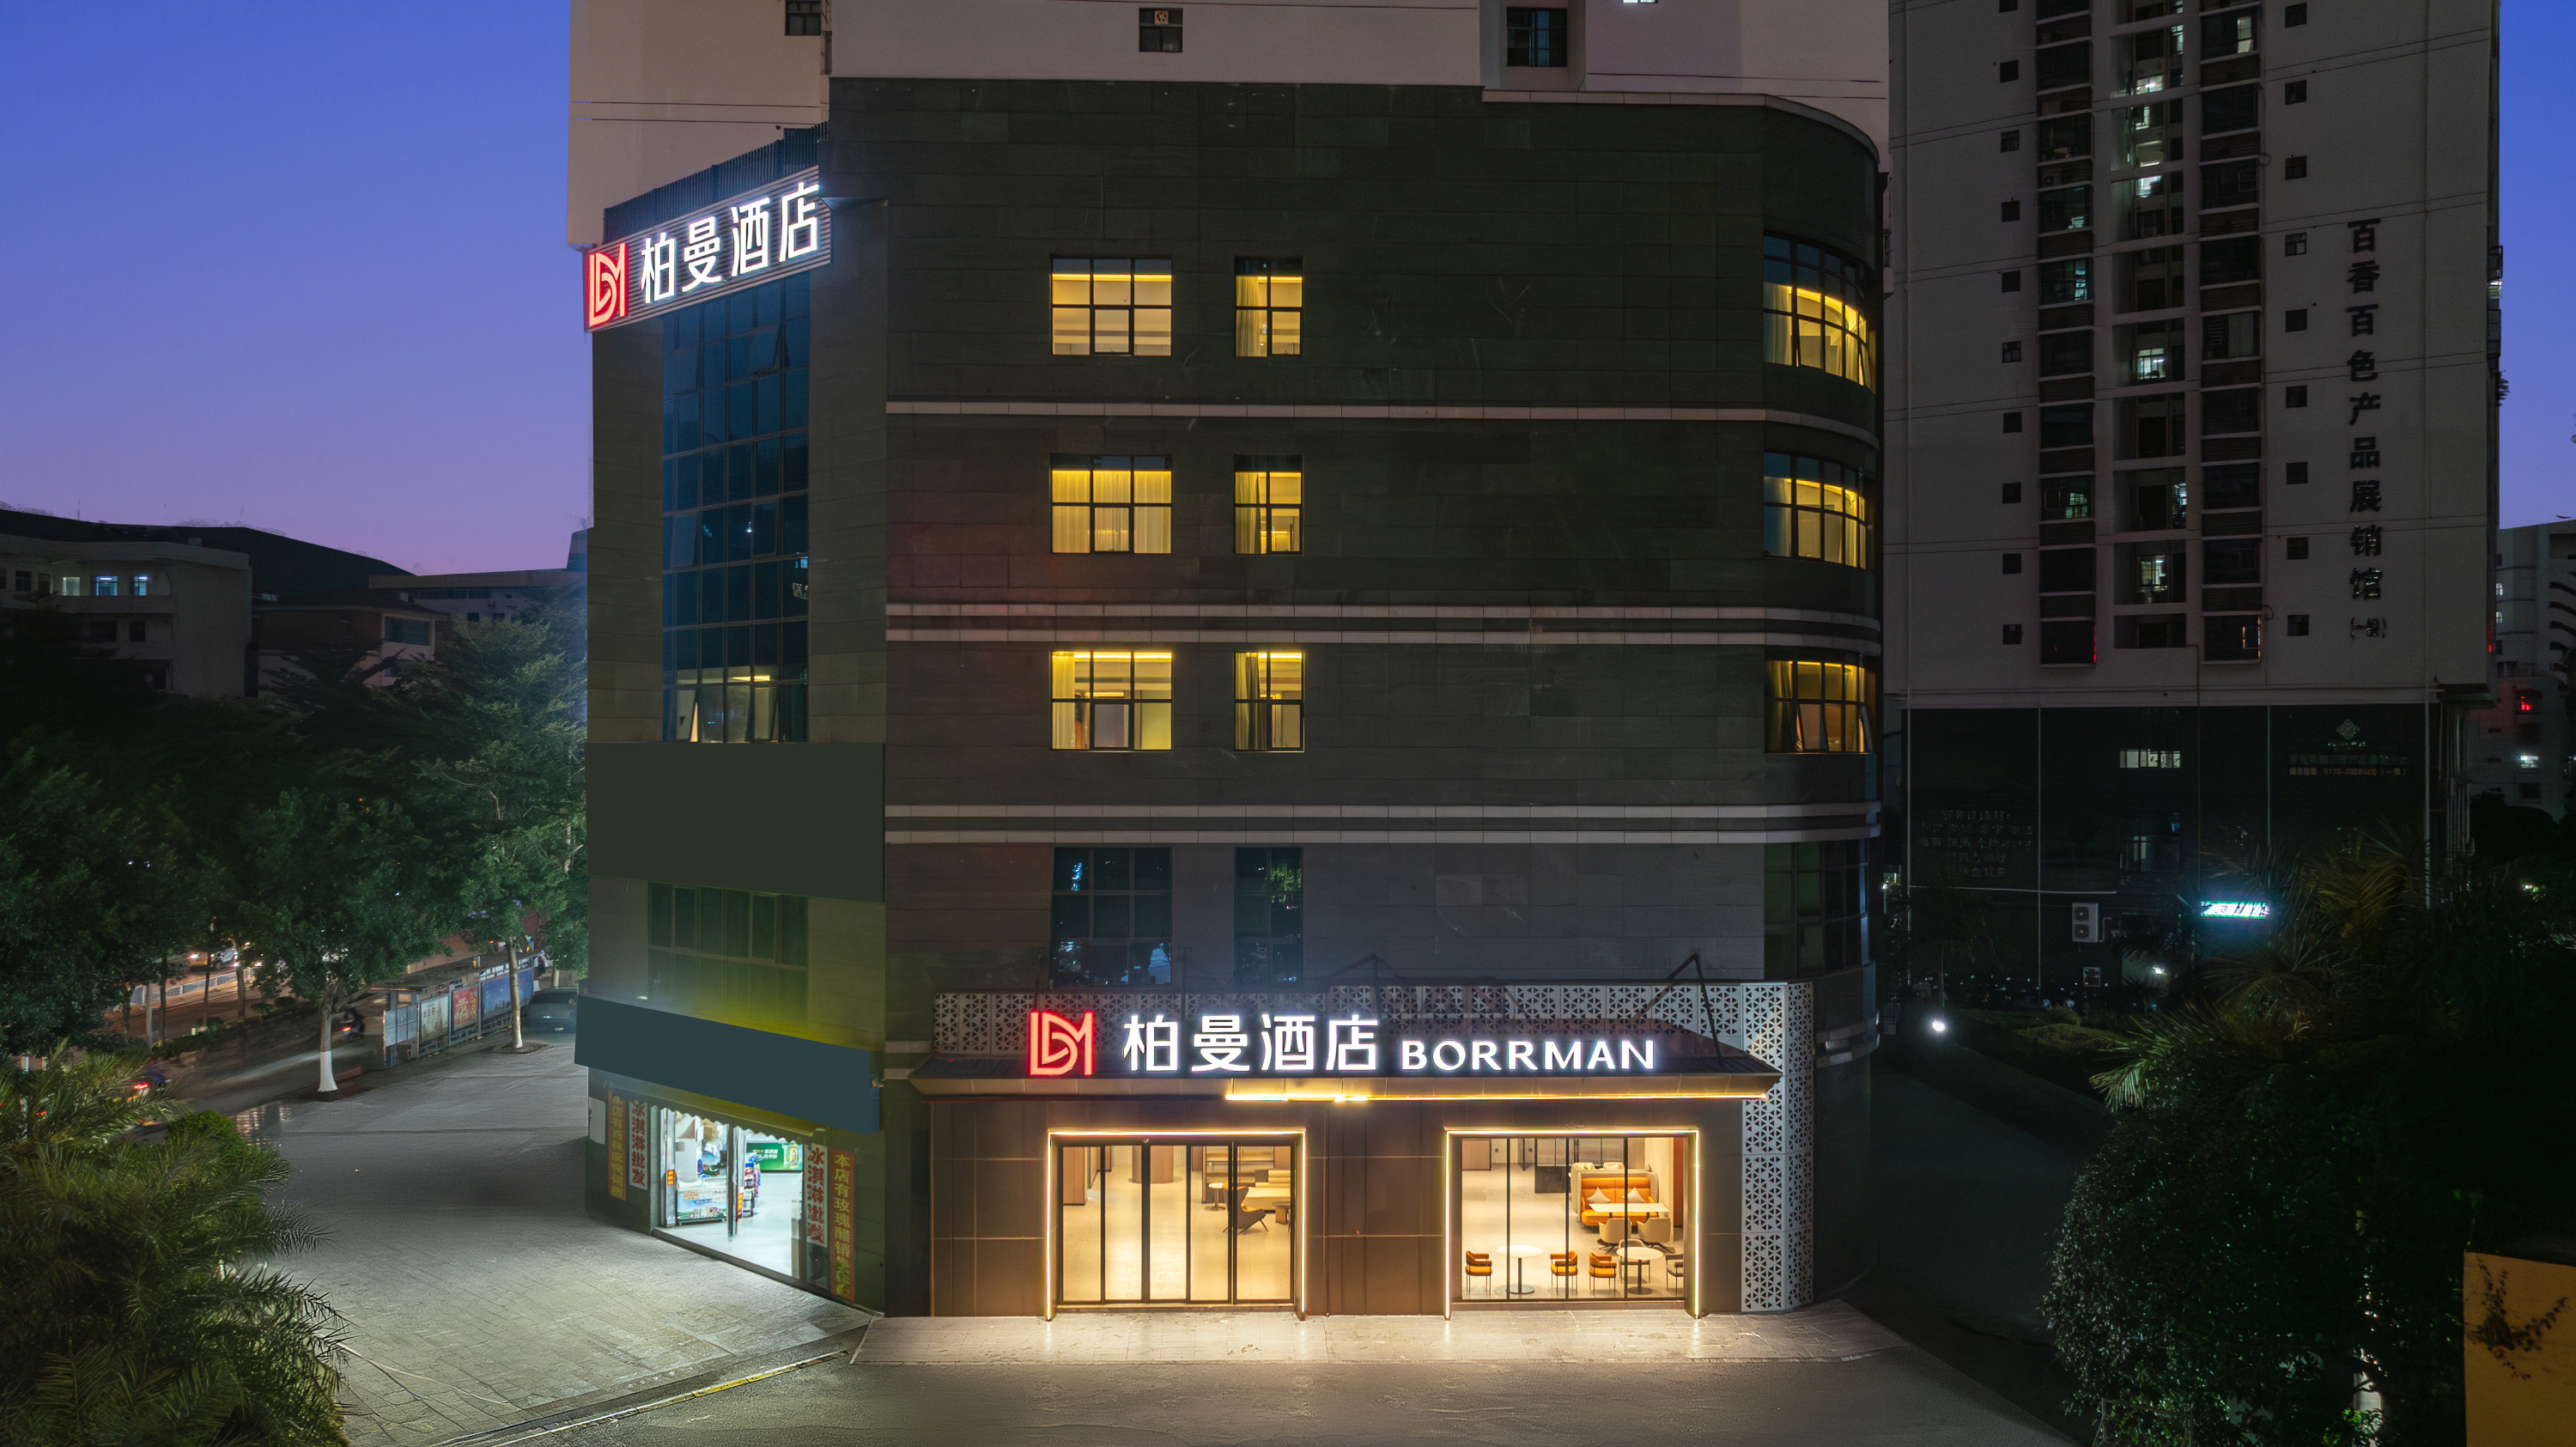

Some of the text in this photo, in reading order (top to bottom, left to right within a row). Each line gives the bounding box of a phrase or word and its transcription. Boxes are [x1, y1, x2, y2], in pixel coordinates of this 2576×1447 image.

[641, 181, 819, 304] 柏曼酒店
[1123, 1013, 1378, 1072] 柏曼酒店
[1401, 1040, 1654, 1071] BORRMAN
